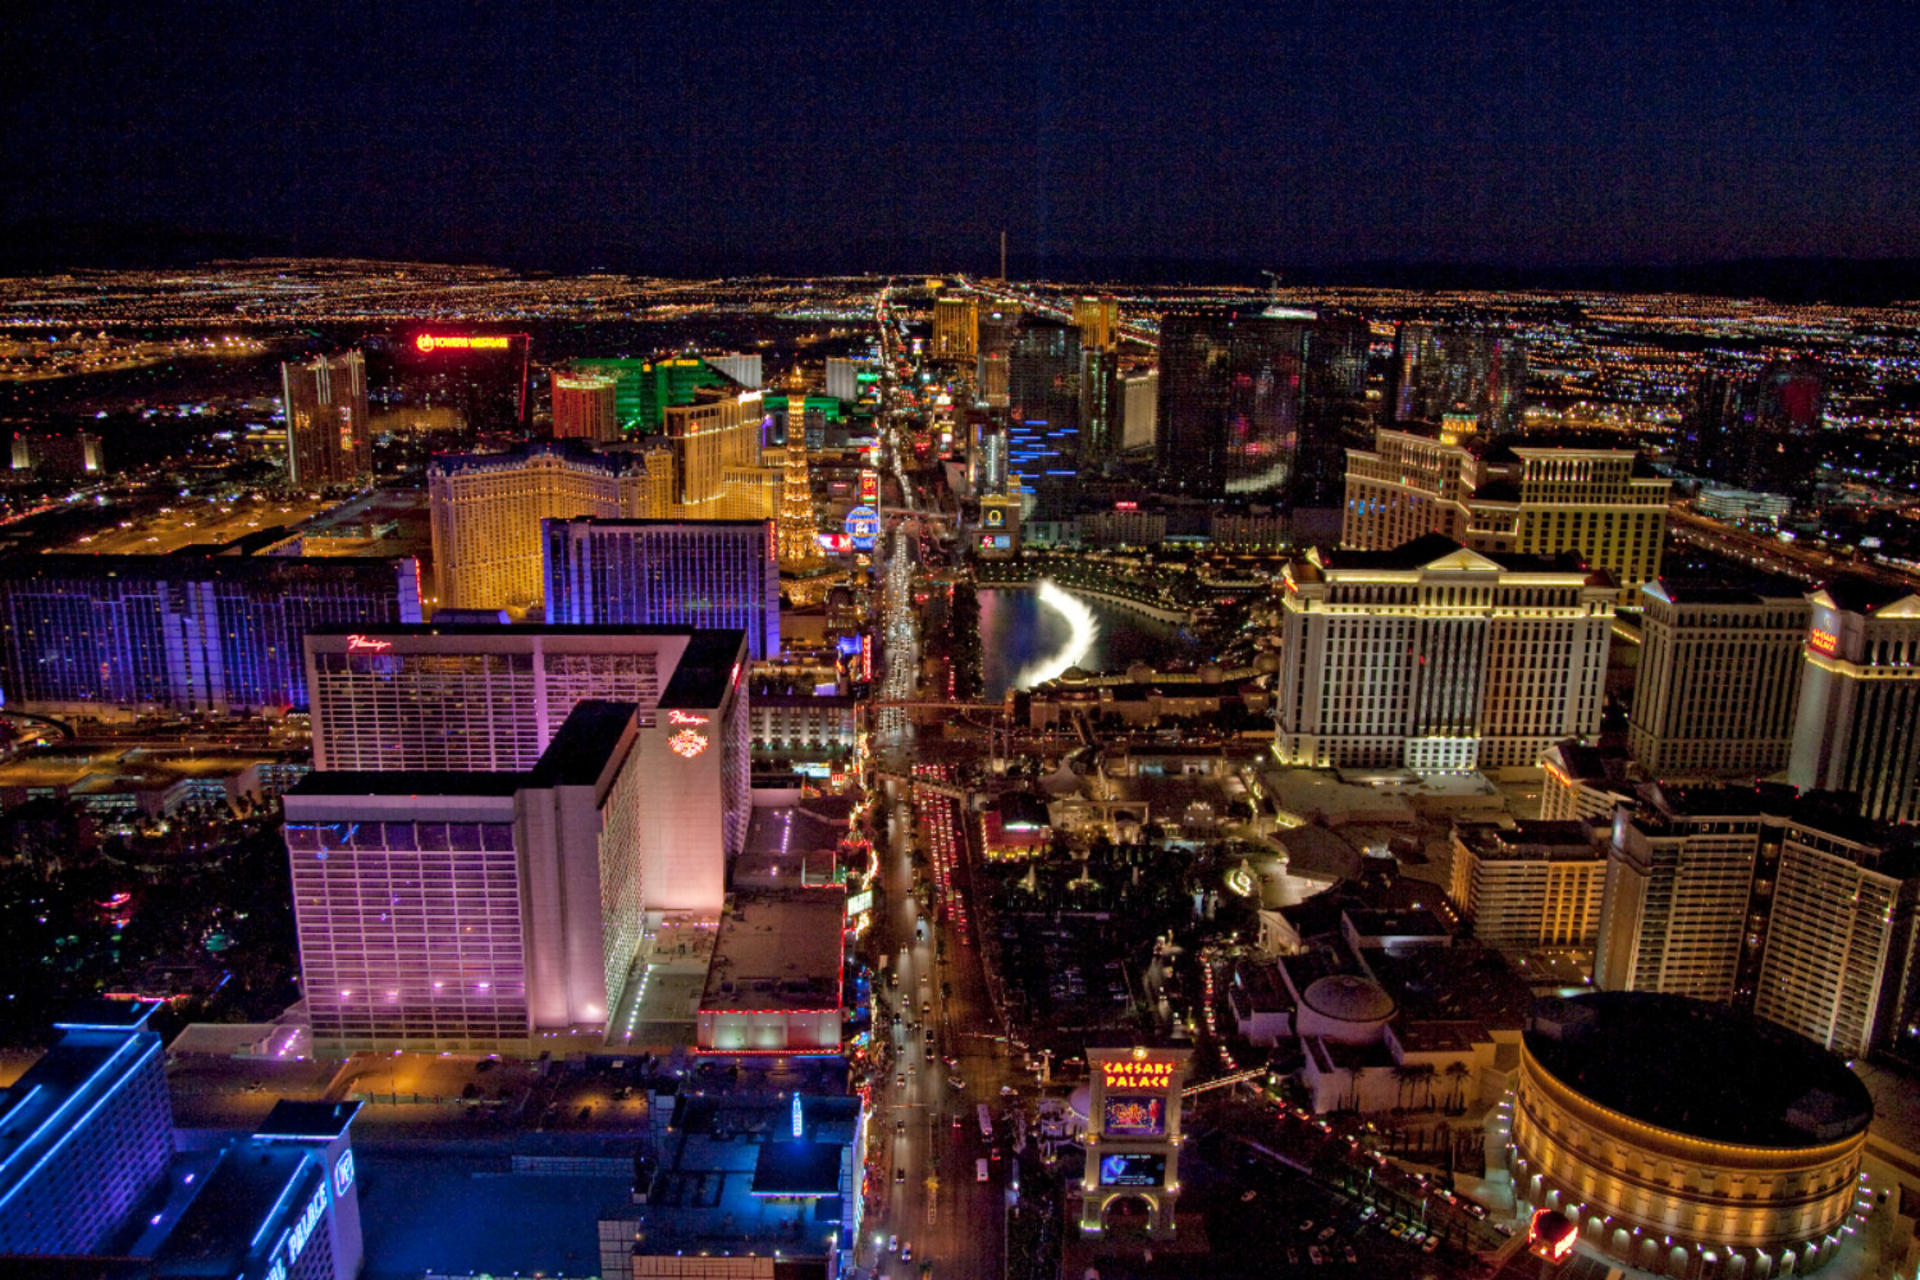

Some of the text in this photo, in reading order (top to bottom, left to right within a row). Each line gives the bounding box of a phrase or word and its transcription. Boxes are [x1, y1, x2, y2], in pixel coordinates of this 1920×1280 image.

[347, 635, 392, 652] Flamingo
[1103, 1062, 1174, 1075] CAESARS
[1105, 1076, 1169, 1088] PALACE
[287, 1181, 328, 1265] PALACE
